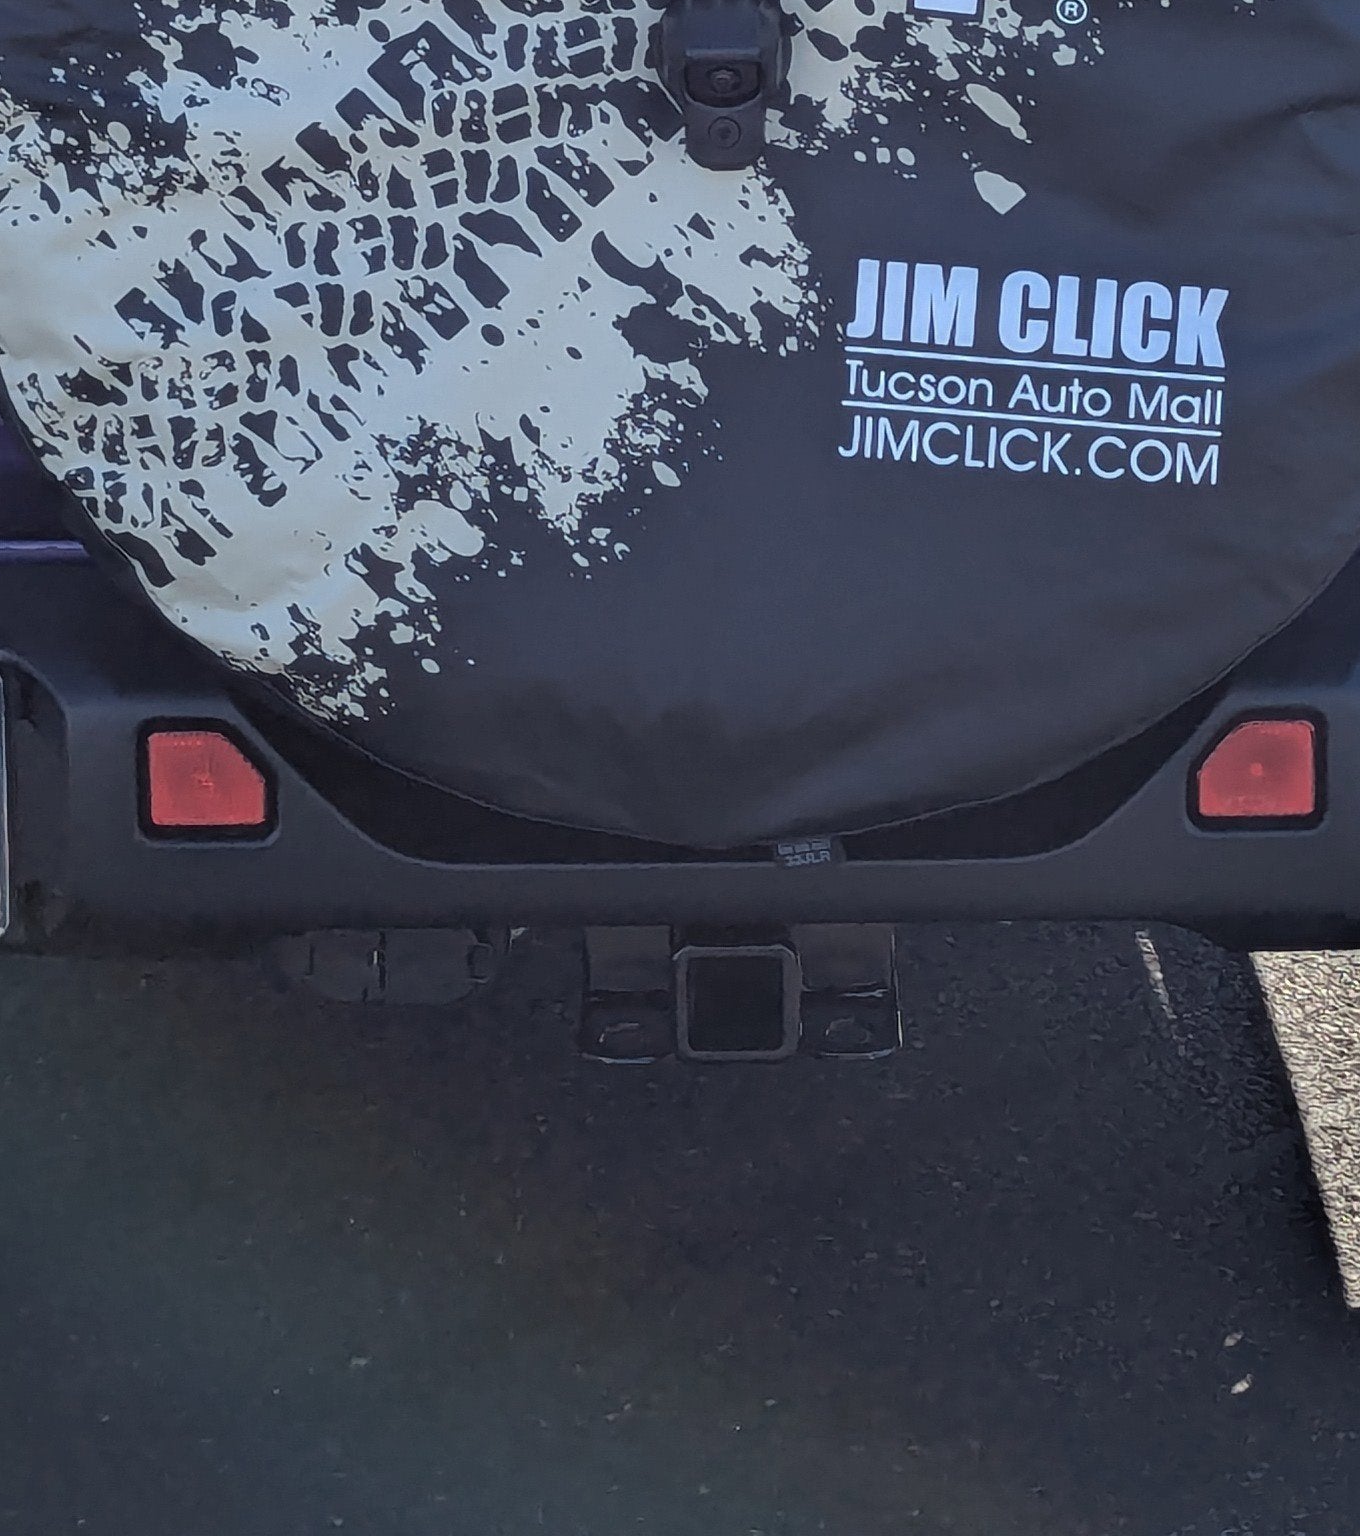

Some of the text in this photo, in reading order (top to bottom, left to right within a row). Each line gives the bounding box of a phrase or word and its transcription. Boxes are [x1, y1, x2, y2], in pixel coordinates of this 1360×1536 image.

[846, 258, 1229, 368] JIM CLICK
[845, 359, 1223, 426] Tucson Auto Mall
[838, 415, 1219, 486] JIMCLICK.COM
